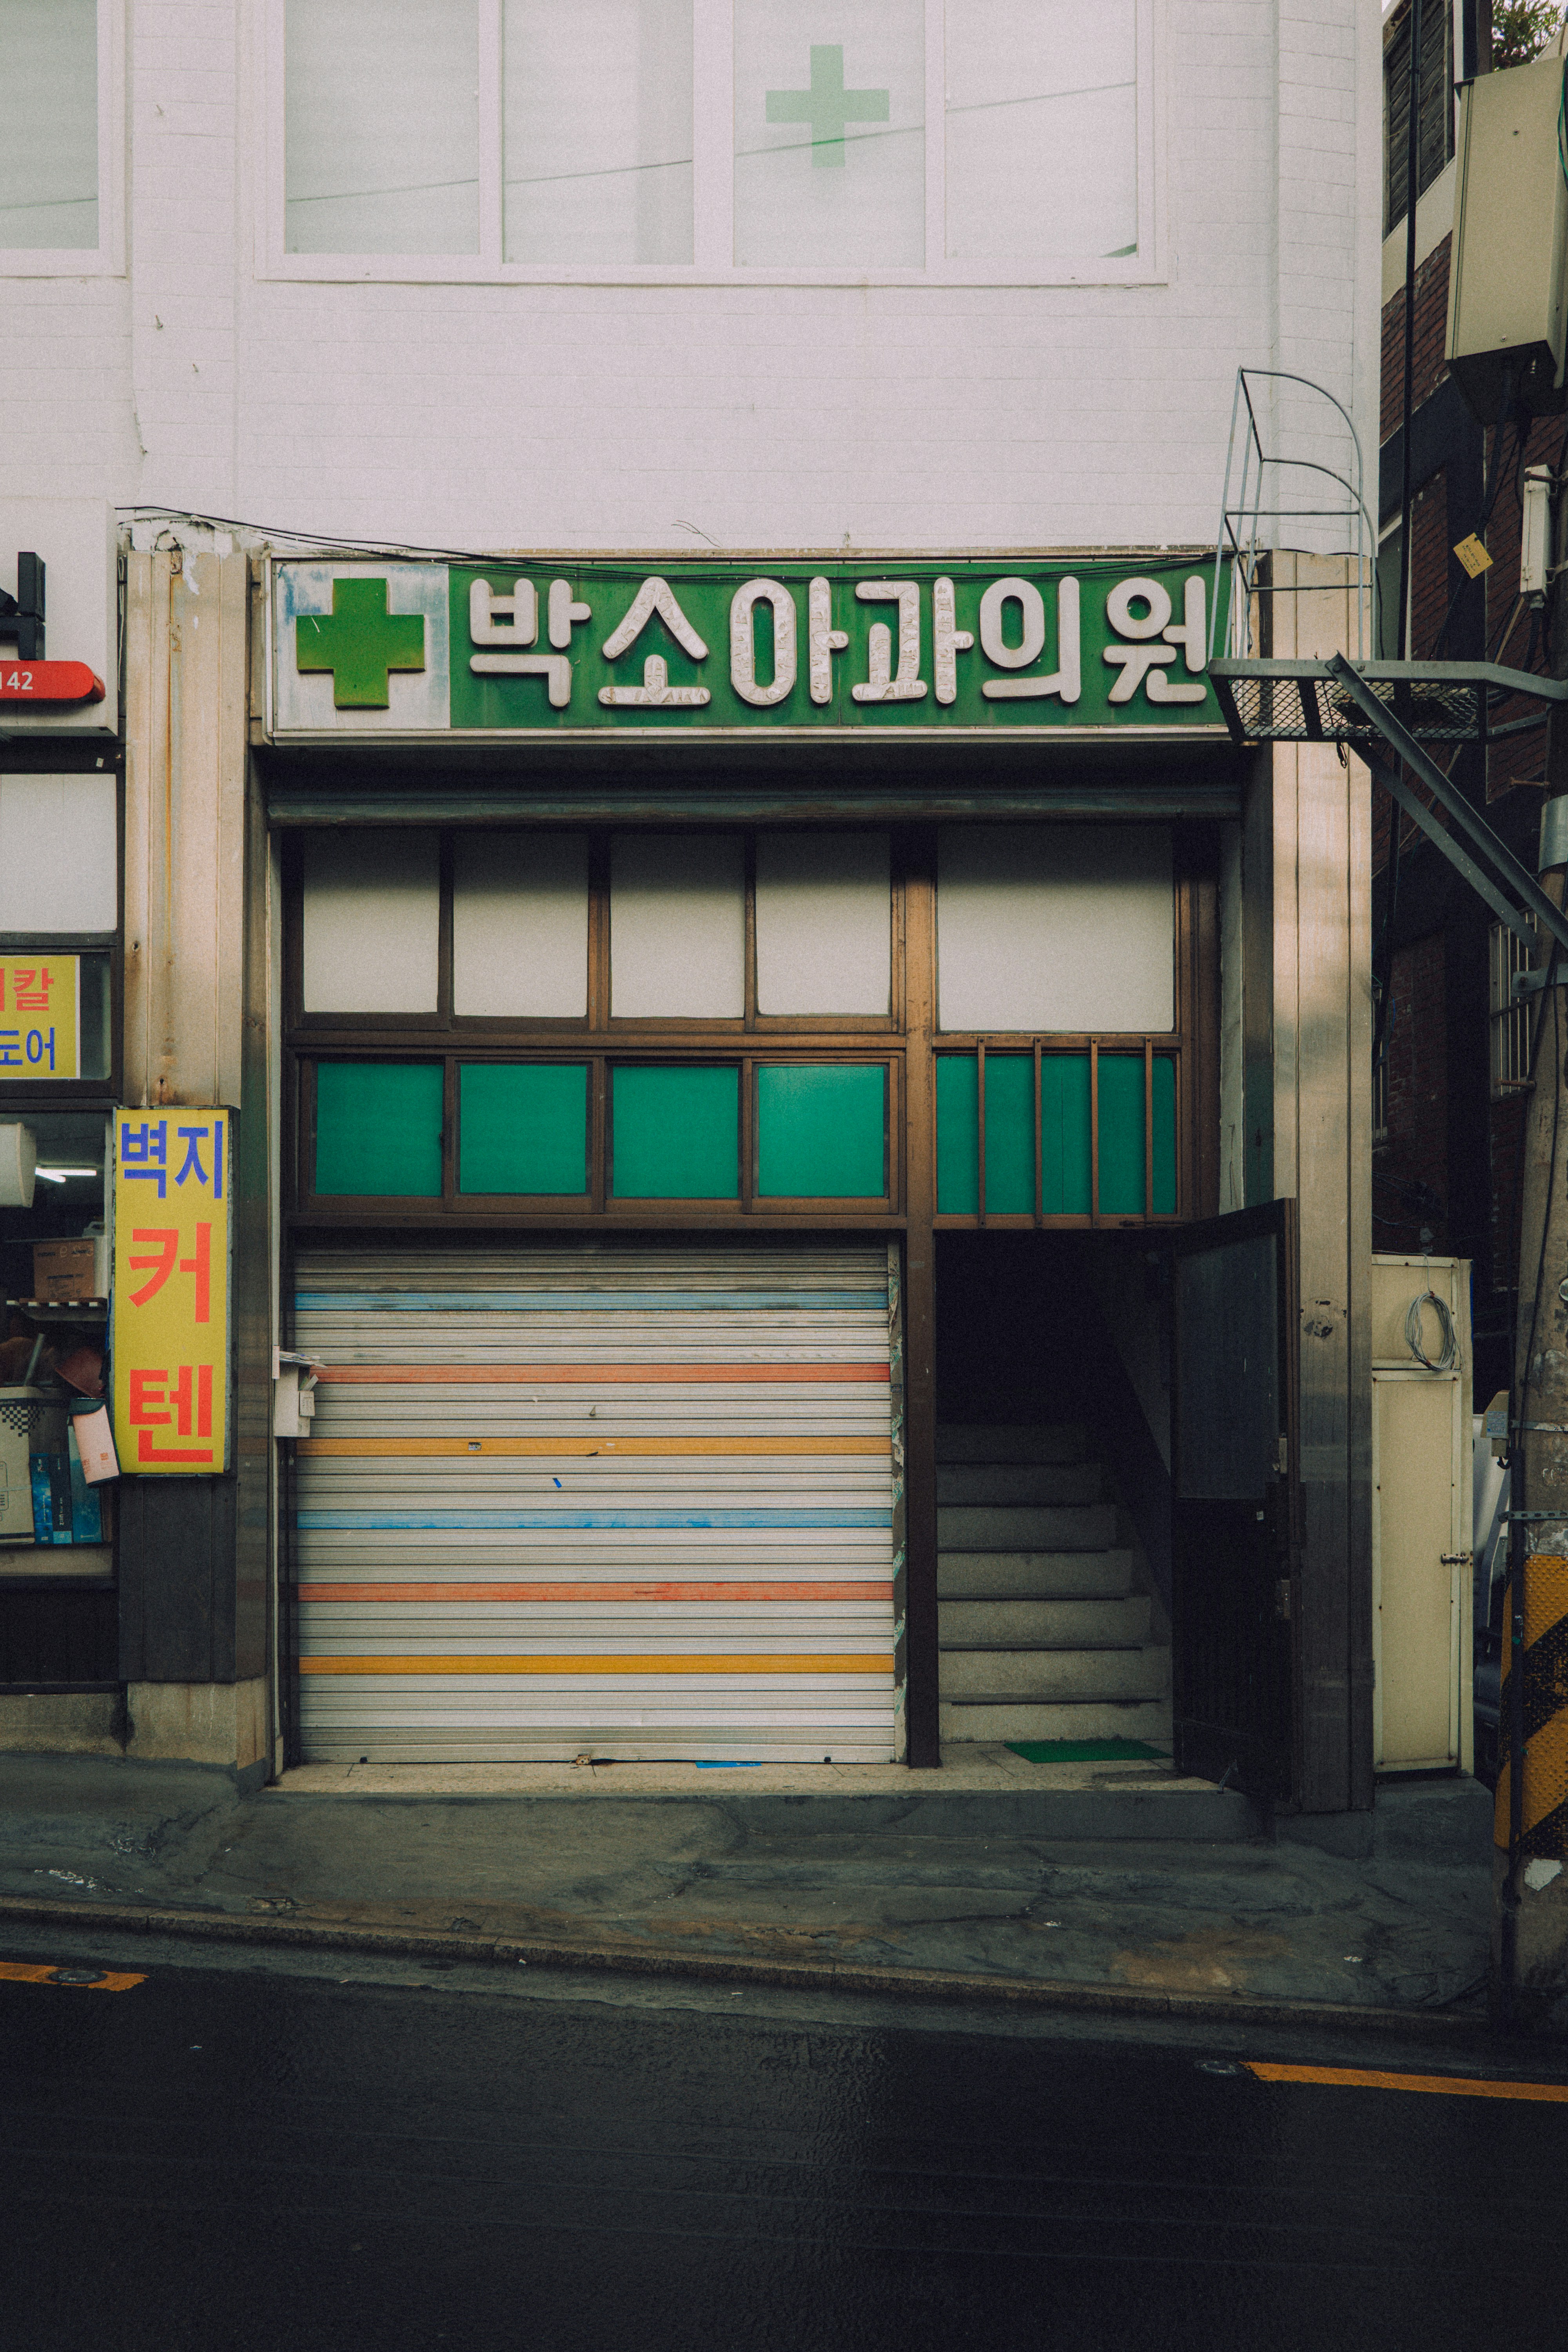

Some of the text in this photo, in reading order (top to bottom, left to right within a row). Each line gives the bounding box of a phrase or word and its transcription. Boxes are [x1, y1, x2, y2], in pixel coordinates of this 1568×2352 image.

[470, 576, 1207, 706] 박소아과의원
[0, 968, 54, 1011] 칼
[121, 1120, 223, 1199] 벽지
[128, 1222, 213, 1463] 커텐
